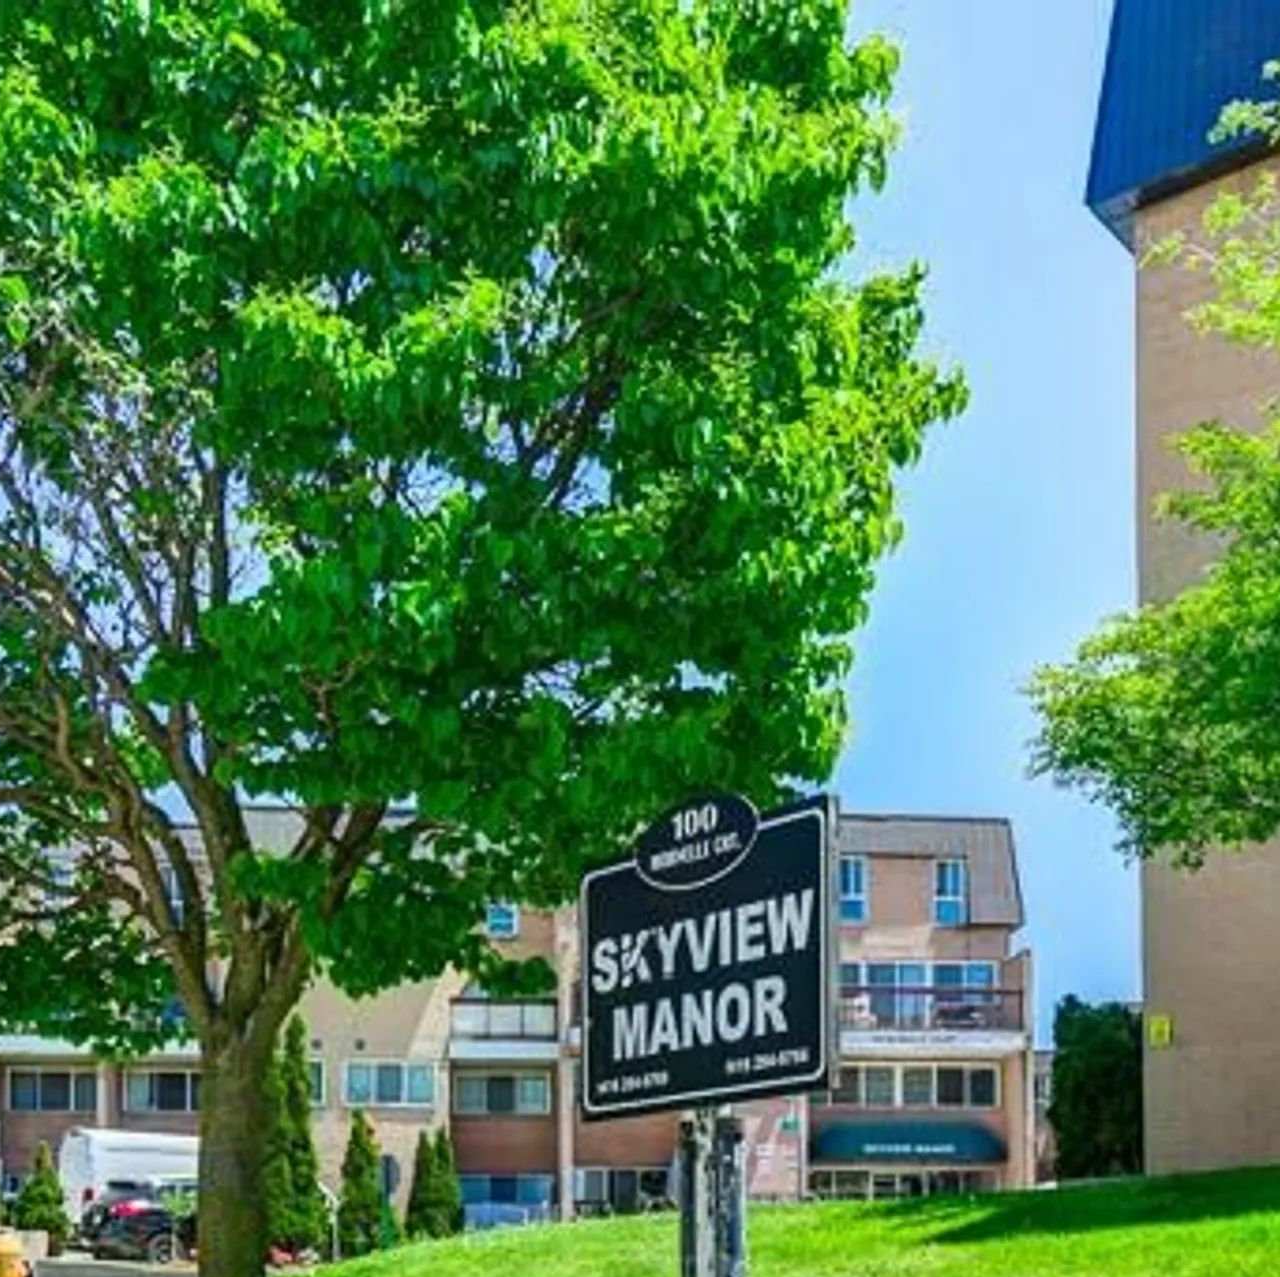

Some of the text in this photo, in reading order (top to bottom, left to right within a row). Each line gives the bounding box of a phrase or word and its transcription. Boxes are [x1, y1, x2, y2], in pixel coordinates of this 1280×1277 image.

[671, 803, 718, 841] 100
[591, 889, 814, 993] SKYVIEW
[613, 976, 788, 1061] MANOR
